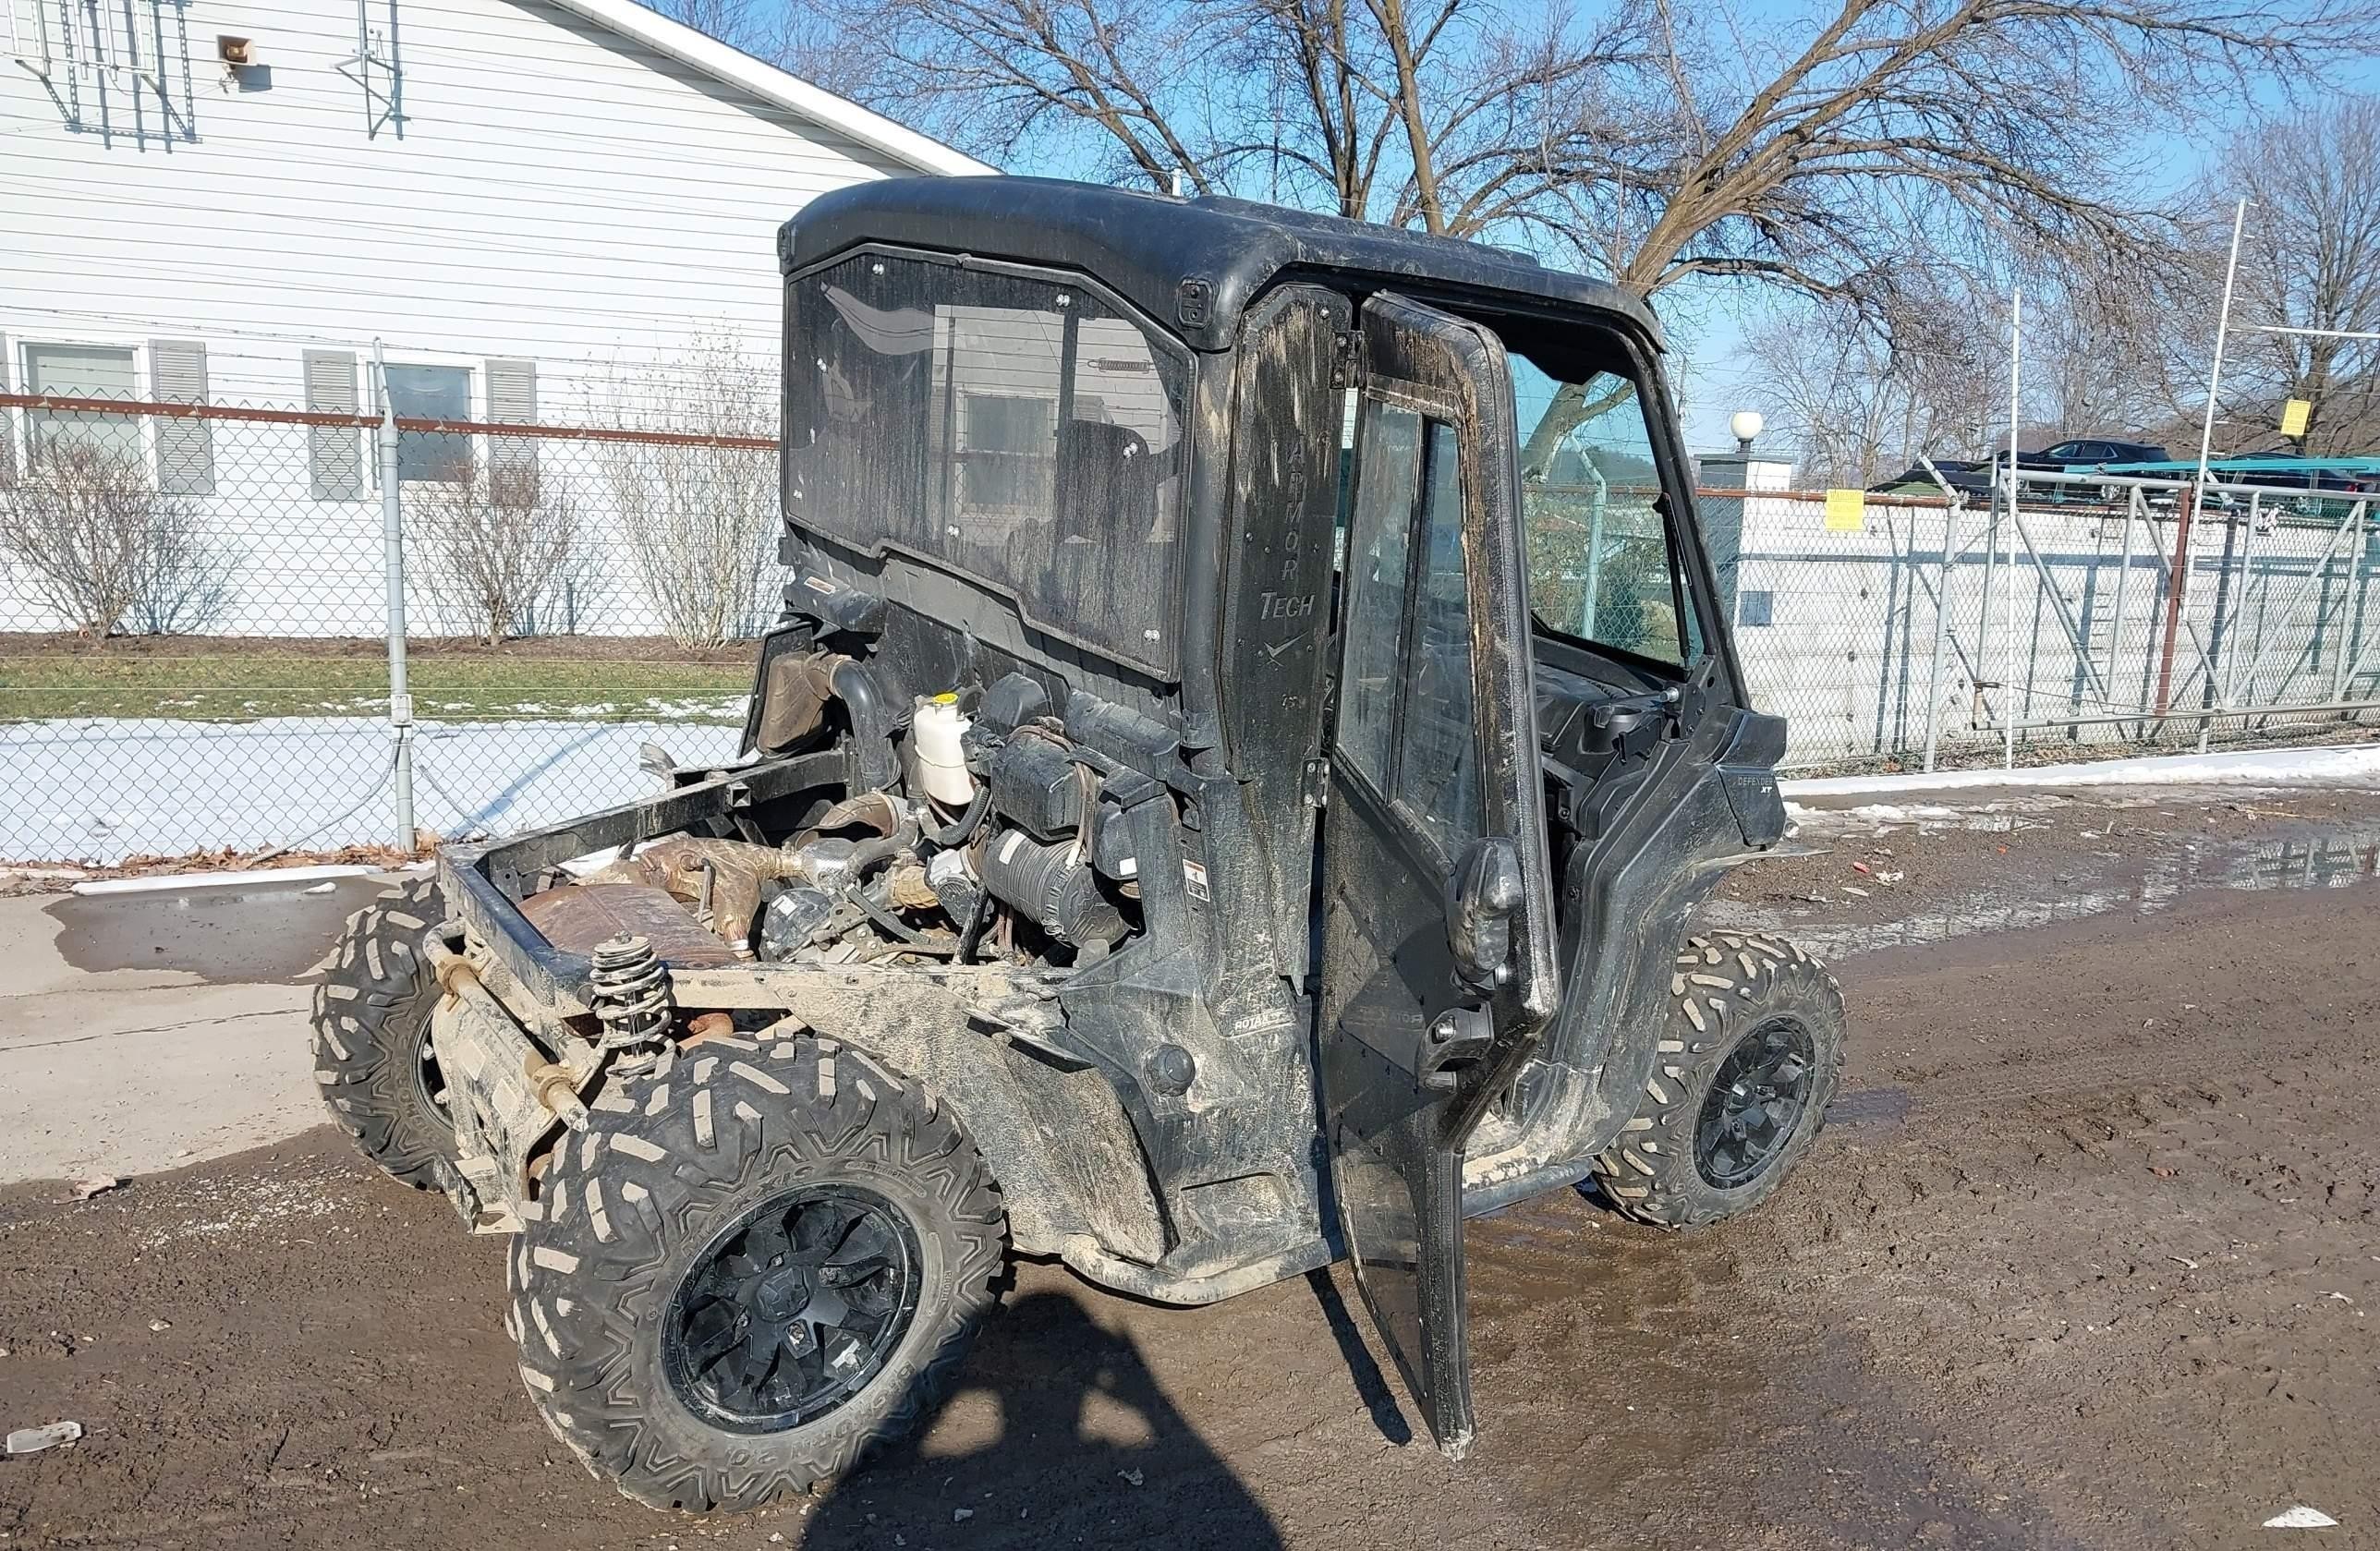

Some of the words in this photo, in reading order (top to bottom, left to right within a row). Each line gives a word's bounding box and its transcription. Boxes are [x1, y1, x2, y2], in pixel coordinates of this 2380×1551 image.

[1260, 591, 1315, 621] TECH
[1738, 776, 1773, 786] DEFENDER
[1760, 785, 1773, 794] XT
[1234, 1014, 1269, 1030] ROTAX
